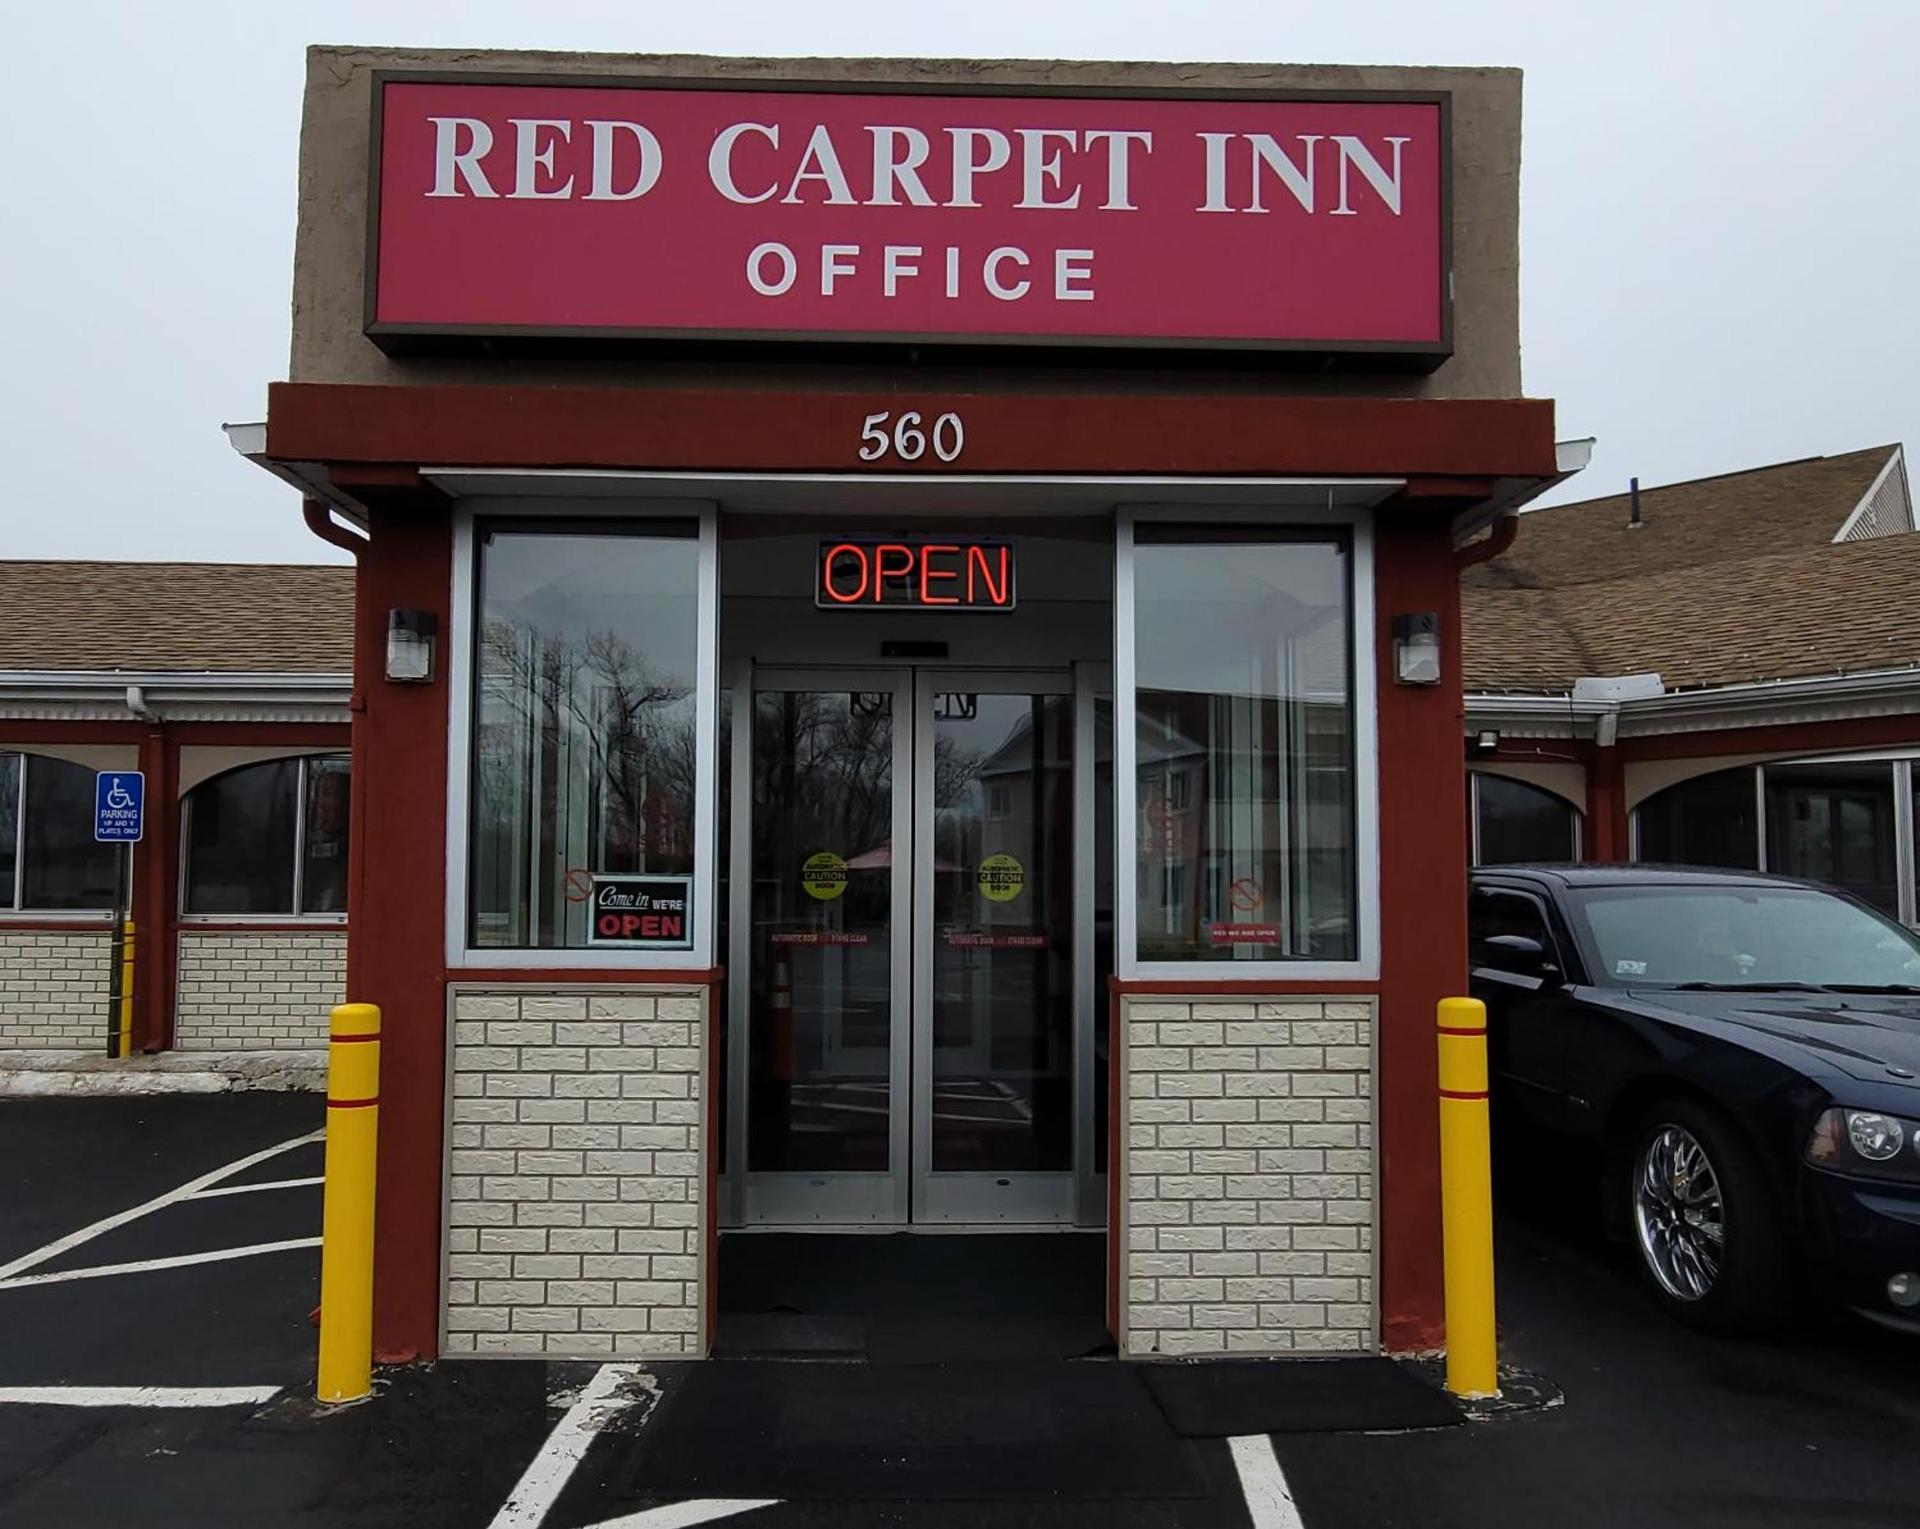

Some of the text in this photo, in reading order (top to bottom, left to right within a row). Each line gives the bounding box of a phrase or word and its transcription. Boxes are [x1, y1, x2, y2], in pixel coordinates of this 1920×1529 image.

[424, 117, 1411, 216] RED CARPET INN
[746, 242, 1095, 301] OFFICE
[858, 410, 964, 462] 560
[823, 543, 1009, 606] OPEN
[100, 809, 138, 819] PARKING
[803, 871, 847, 881] CAUTION
[979, 873, 1022, 883] CAUTION
[599, 885, 683, 910] Come in WE'RE
[598, 914, 681, 937] OPEN
